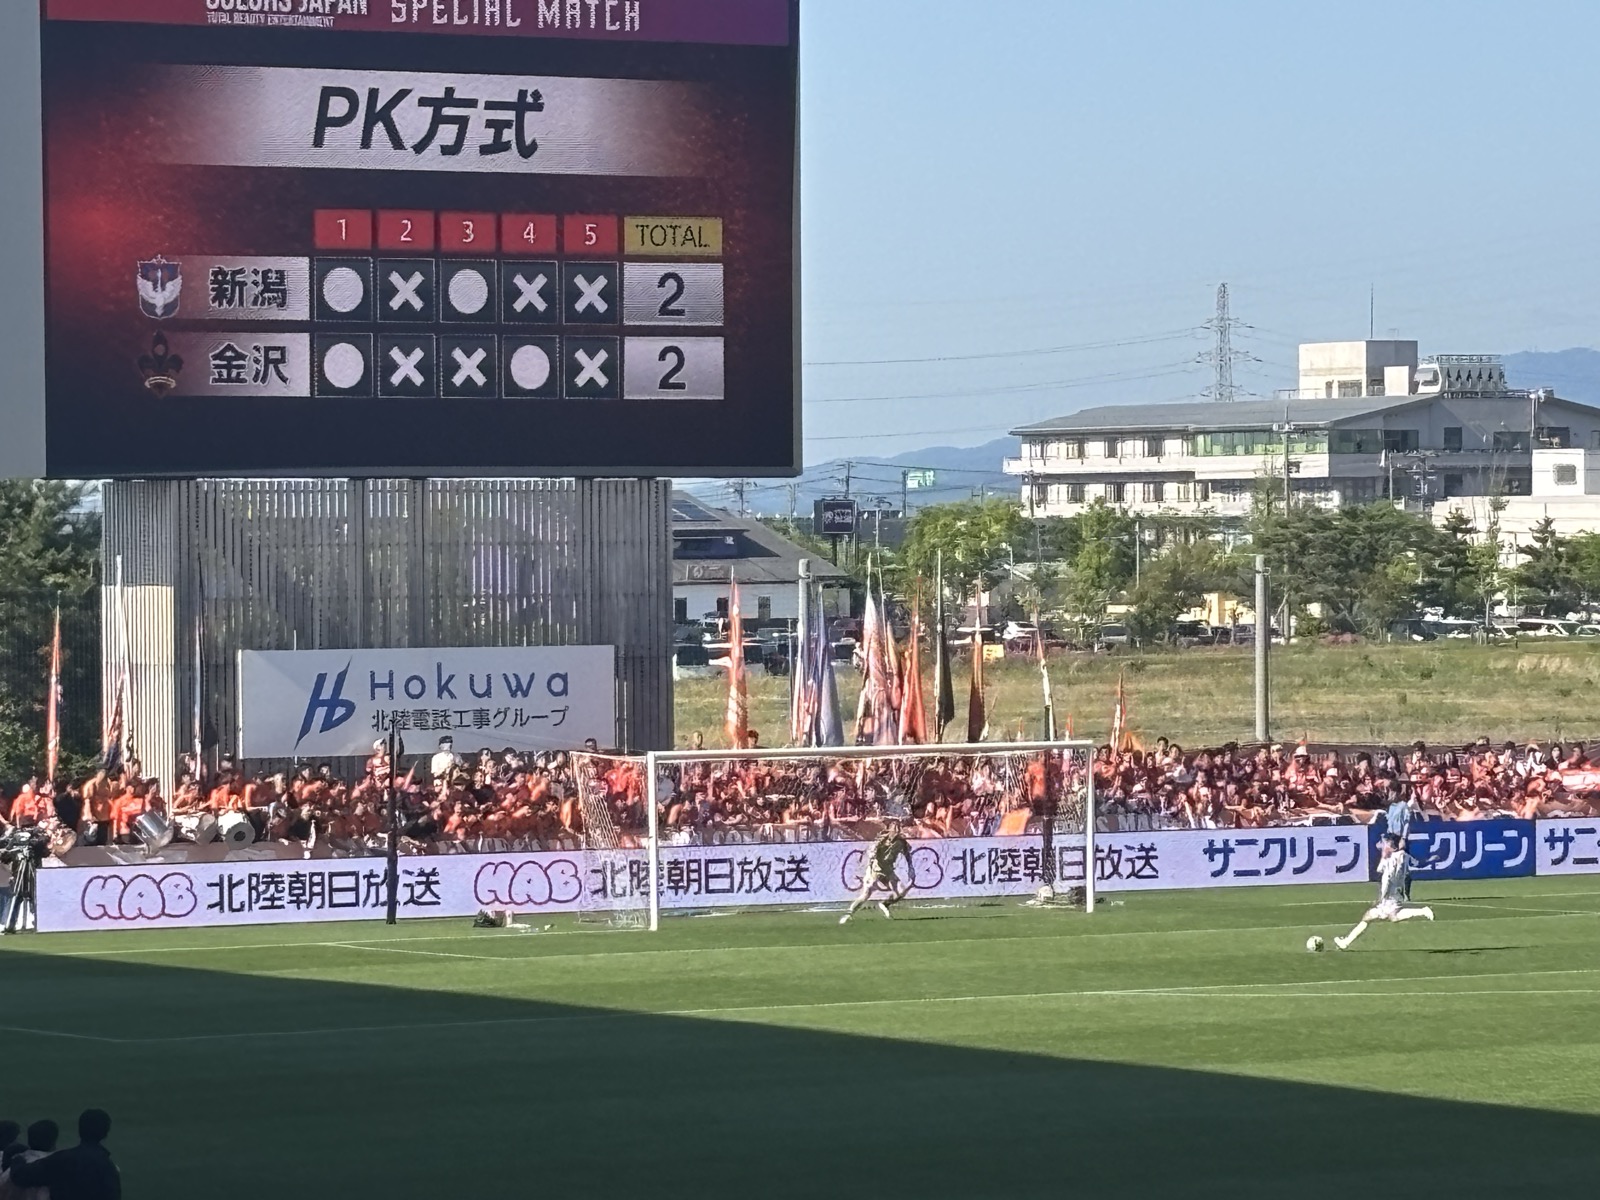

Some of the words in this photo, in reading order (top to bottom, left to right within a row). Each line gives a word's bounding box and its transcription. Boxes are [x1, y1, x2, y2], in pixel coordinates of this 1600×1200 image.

[391, 0, 521, 28] SPECIAL
[537, 0, 640, 31] MATCH
[311, 85, 546, 160] PK方式
[336, 219, 348, 241] 1
[400, 220, 412, 241] 2
[462, 221, 474, 242] 3
[522, 221, 536, 243] 4
[584, 223, 597, 246] 5
[635, 223, 711, 249] TOTAL
[208, 266, 288, 308] 新潟
[657, 273, 684, 316] 2
[208, 343, 289, 385] 金沢
[658, 346, 686, 390] 2
[369, 661, 569, 701] Hokuwa
[951, 842, 1159, 885] 北陸朝日放送
[1203, 835, 1360, 878] サニクリーン
[1408, 829, 1528, 871] ニクリーン
[1544, 826, 1600, 866] サニ
[206, 867, 441, 914] 北陸朝日放送
[590, 853, 810, 898] 北陸朝日放送
